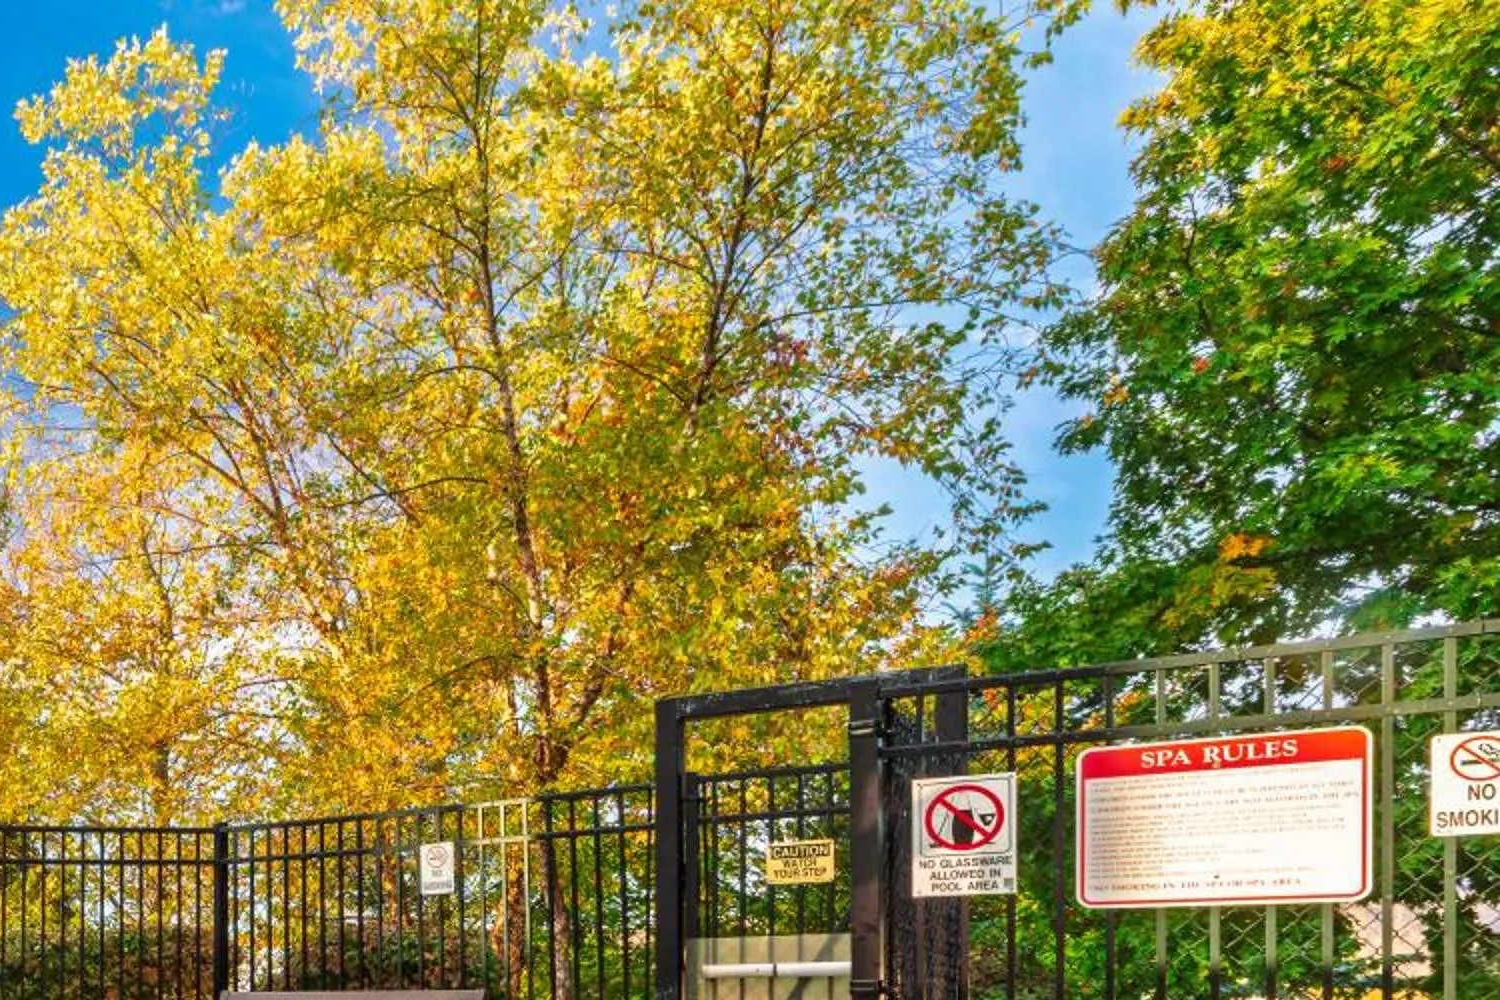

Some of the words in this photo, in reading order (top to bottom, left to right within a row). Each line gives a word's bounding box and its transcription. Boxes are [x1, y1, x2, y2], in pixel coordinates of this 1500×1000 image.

[1140, 751, 1192, 769] SPA
[1202, 739, 1299, 764] RULES
[1467, 783, 1497, 801] NO
[1436, 808, 1499, 829] SMOKI
[773, 845, 829, 858] CAUTION
[919, 859, 936, 870] NO
[939, 855, 1013, 869] GLASSWARE
[929, 869, 985, 881] ALLOWED
[989, 868, 1002, 877] IN
[931, 881, 963, 893] POOL
[967, 880, 999, 891] AREA
